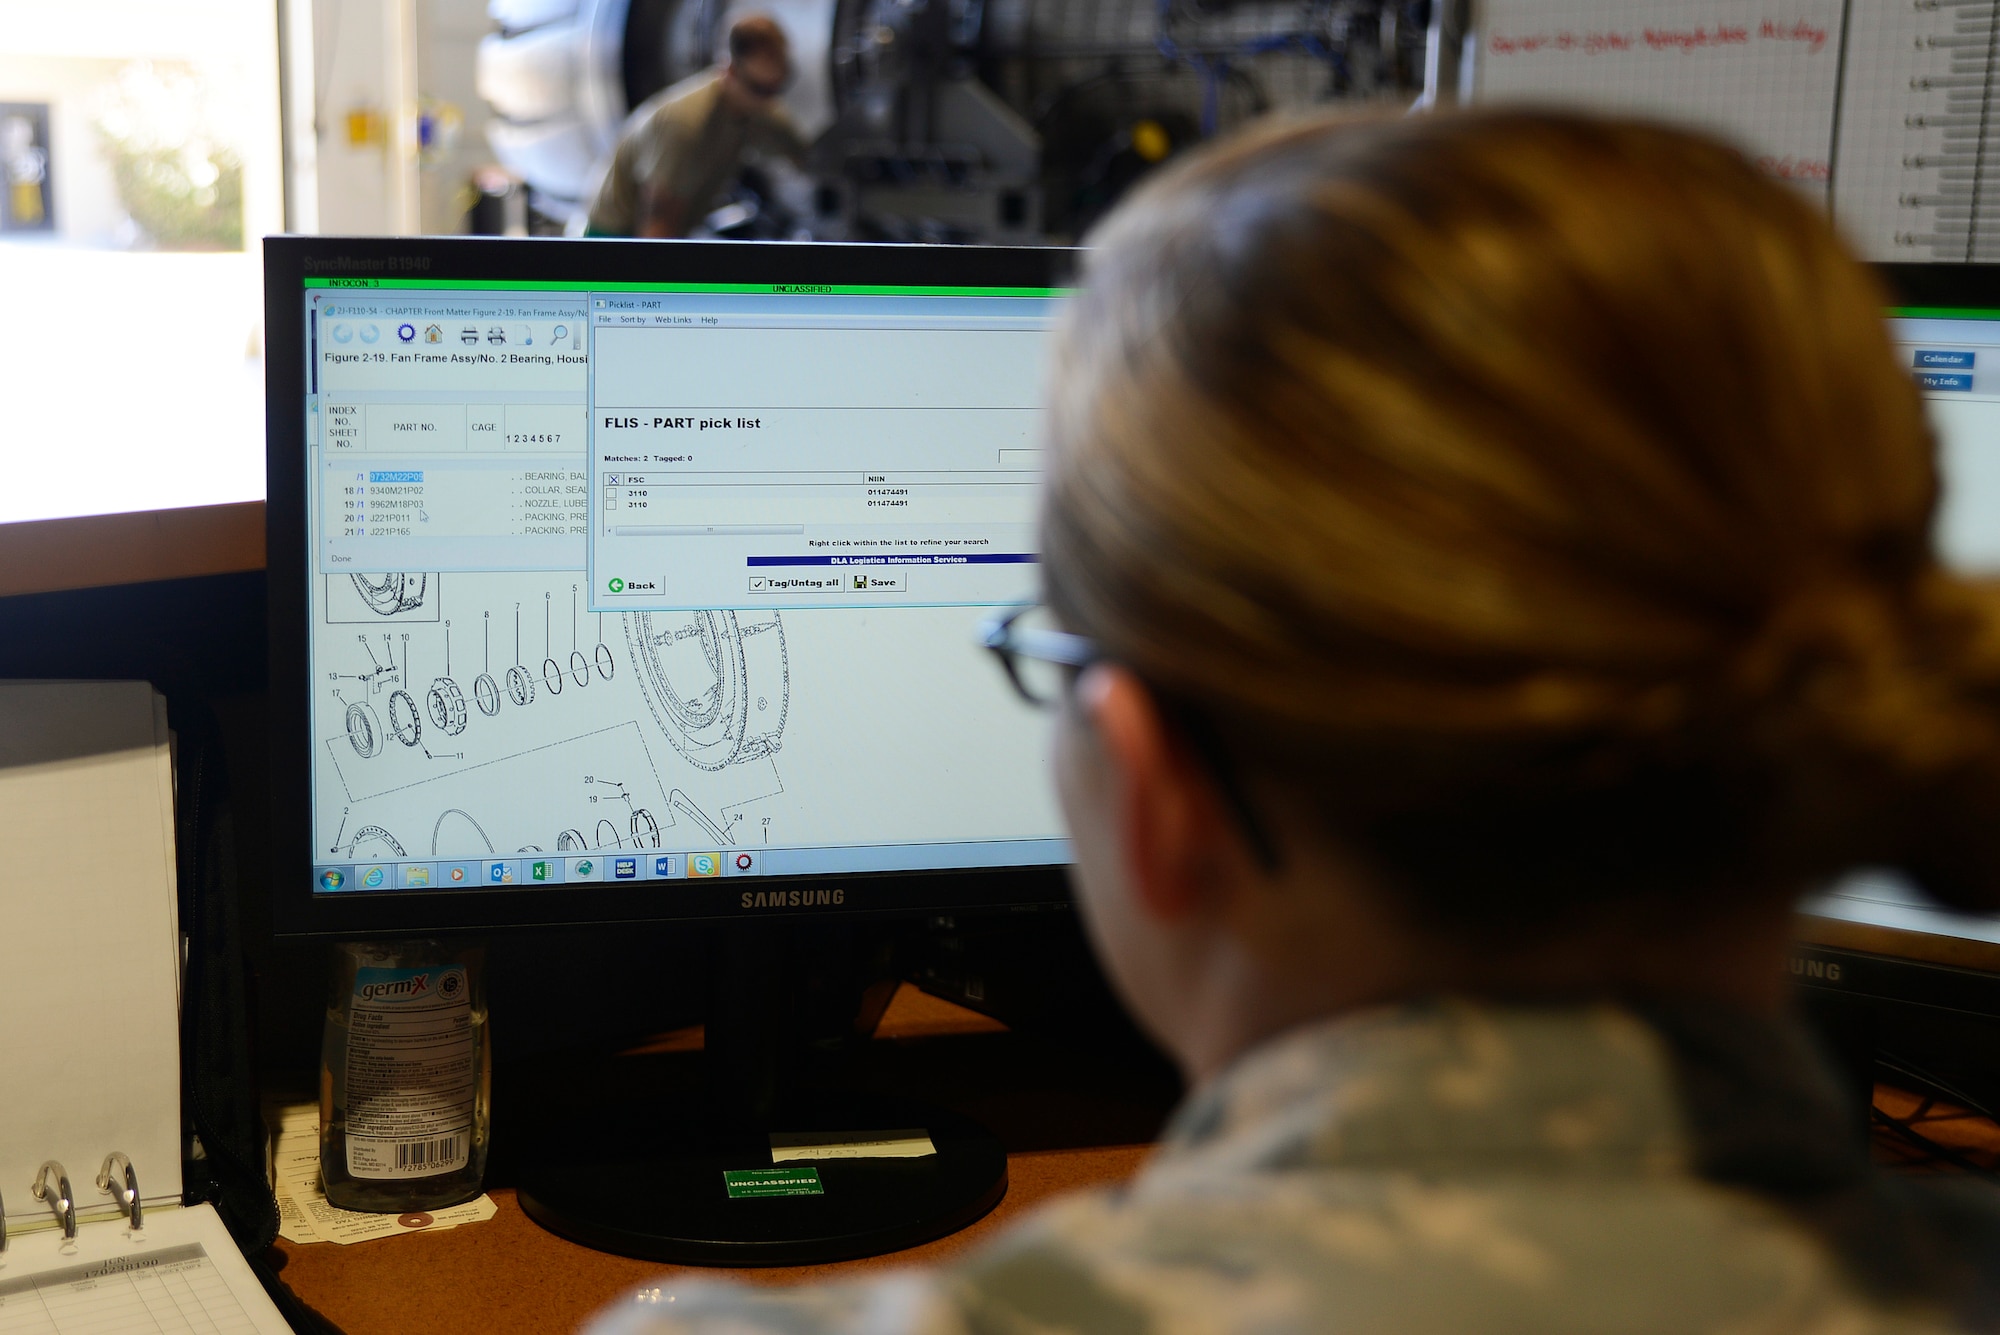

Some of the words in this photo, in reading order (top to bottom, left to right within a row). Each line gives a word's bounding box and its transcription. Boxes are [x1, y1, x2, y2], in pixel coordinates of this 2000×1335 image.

[304, 256, 384, 272] SyncMaster
[330, 280, 368, 288] INFOCON
[374, 280, 380, 288] 3
[772, 285, 832, 293] UNCLASSIFIED
[609, 301, 634, 309] Picklist
[642, 301, 662, 309] PART
[386, 307, 422, 316] CHAPTER
[424, 308, 444, 316] Front
[446, 308, 471, 316] Matter
[474, 308, 496, 318] Figure
[518, 309, 532, 317] Fan
[534, 309, 556, 317] Frame
[598, 316, 612, 324] File
[620, 316, 634, 324] Sort
[636, 316, 646, 325] by
[655, 316, 672, 324] Web
[674, 316, 692, 324] Links
[701, 316, 718, 325] Help
[325, 353, 360, 365] Figure
[362, 353, 388, 362] 2-19.
[392, 354, 411, 362] Fan
[414, 354, 448, 363] Frame
[450, 354, 498, 365] Assy/No.
[501, 354, 507, 363] 2
[510, 354, 554, 366] Bearing,
[557, 354, 588, 364] Housi
[1924, 355, 1963, 364] Calendar
[1924, 378, 1938, 386] My
[1940, 378, 1958, 386] Info
[329, 406, 357, 415] INDEX
[335, 417, 351, 426] NO.
[605, 418, 639, 428] FLIS
[654, 418, 695, 428] PART
[700, 417, 732, 431] pick
[737, 417, 761, 428] list
[394, 423, 418, 432] PART
[421, 423, 437, 432] NO.
[472, 423, 497, 432] CAGE
[329, 428, 358, 437] SHEET
[506, 434, 511, 443] 1
[514, 434, 520, 443] 2
[522, 434, 528, 443] 3
[530, 434, 536, 443] 4
[539, 434, 544, 443] 5
[547, 434, 553, 443] 6
[556, 434, 561, 443] 7
[336, 440, 353, 448] NO.
[654, 455, 686, 464] Tagged:
[356, 473, 364, 481] /1
[525, 472, 567, 481] BEARING,
[344, 487, 354, 495] 18
[356, 487, 364, 495] /1
[370, 487, 424, 495] 9340M21P02
[525, 486, 562, 494] COLLAR,
[344, 501, 354, 509] 19
[356, 501, 364, 509] /1
[370, 501, 424, 509] 9962M18P03
[525, 500, 561, 508] NOZZLE,
[344, 514, 354, 522] 20
[356, 514, 364, 522] /1
[370, 514, 410, 522] J221P011
[525, 513, 567, 522] PACKING,
[344, 528, 354, 536] 21
[356, 528, 364, 536] /1
[370, 528, 410, 536] J221P165
[525, 526, 567, 535] PACKING,
[809, 539, 829, 548] Right
[944, 539, 961, 547] your
[331, 554, 352, 563] Done
[831, 556, 848, 564] DLA
[850, 556, 885, 566] Logistics
[888, 556, 932, 564] Information
[628, 582, 656, 590] Back
[768, 578, 822, 589] Tag/Untag
[826, 578, 839, 586] all
[871, 578, 896, 587] Save
[358, 634, 366, 642] 15
[384, 634, 391, 642] 14
[401, 634, 410, 642] 10
[584, 776, 594, 784] 20
[590, 795, 598, 803] 19
[344, 806, 349, 815] 2
[734, 814, 742, 822] 24
[762, 818, 771, 826] 27
[742, 889, 844, 908] SAMSUNG
[730, 1178, 816, 1187] UNCLASSIFIED
